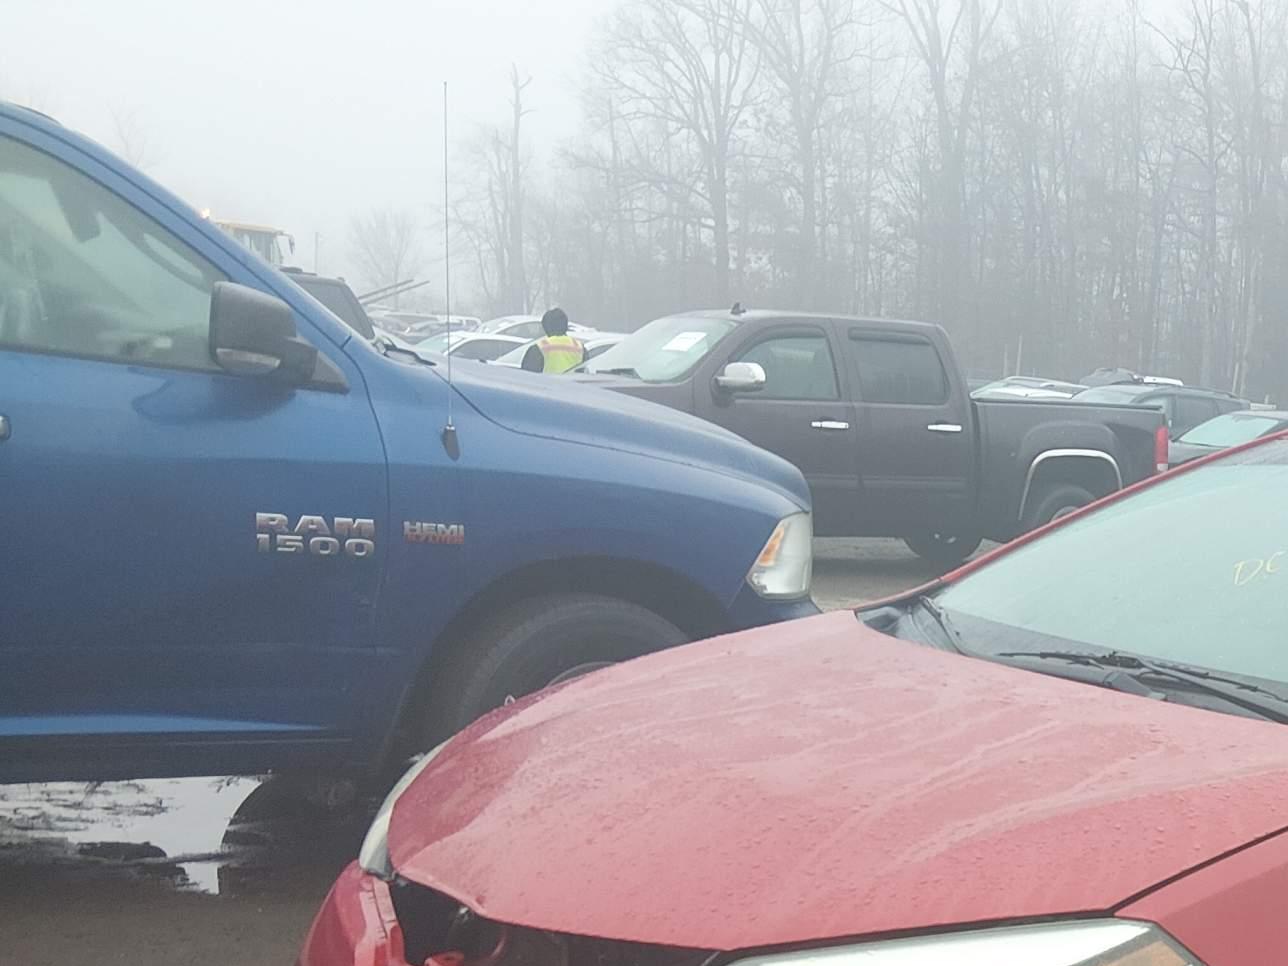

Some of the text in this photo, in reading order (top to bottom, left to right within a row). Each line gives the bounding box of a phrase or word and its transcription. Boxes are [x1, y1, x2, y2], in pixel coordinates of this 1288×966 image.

[255, 512, 375, 536] RAM
[403, 520, 465, 536] HEMI
[256, 533, 375, 556] 1500
